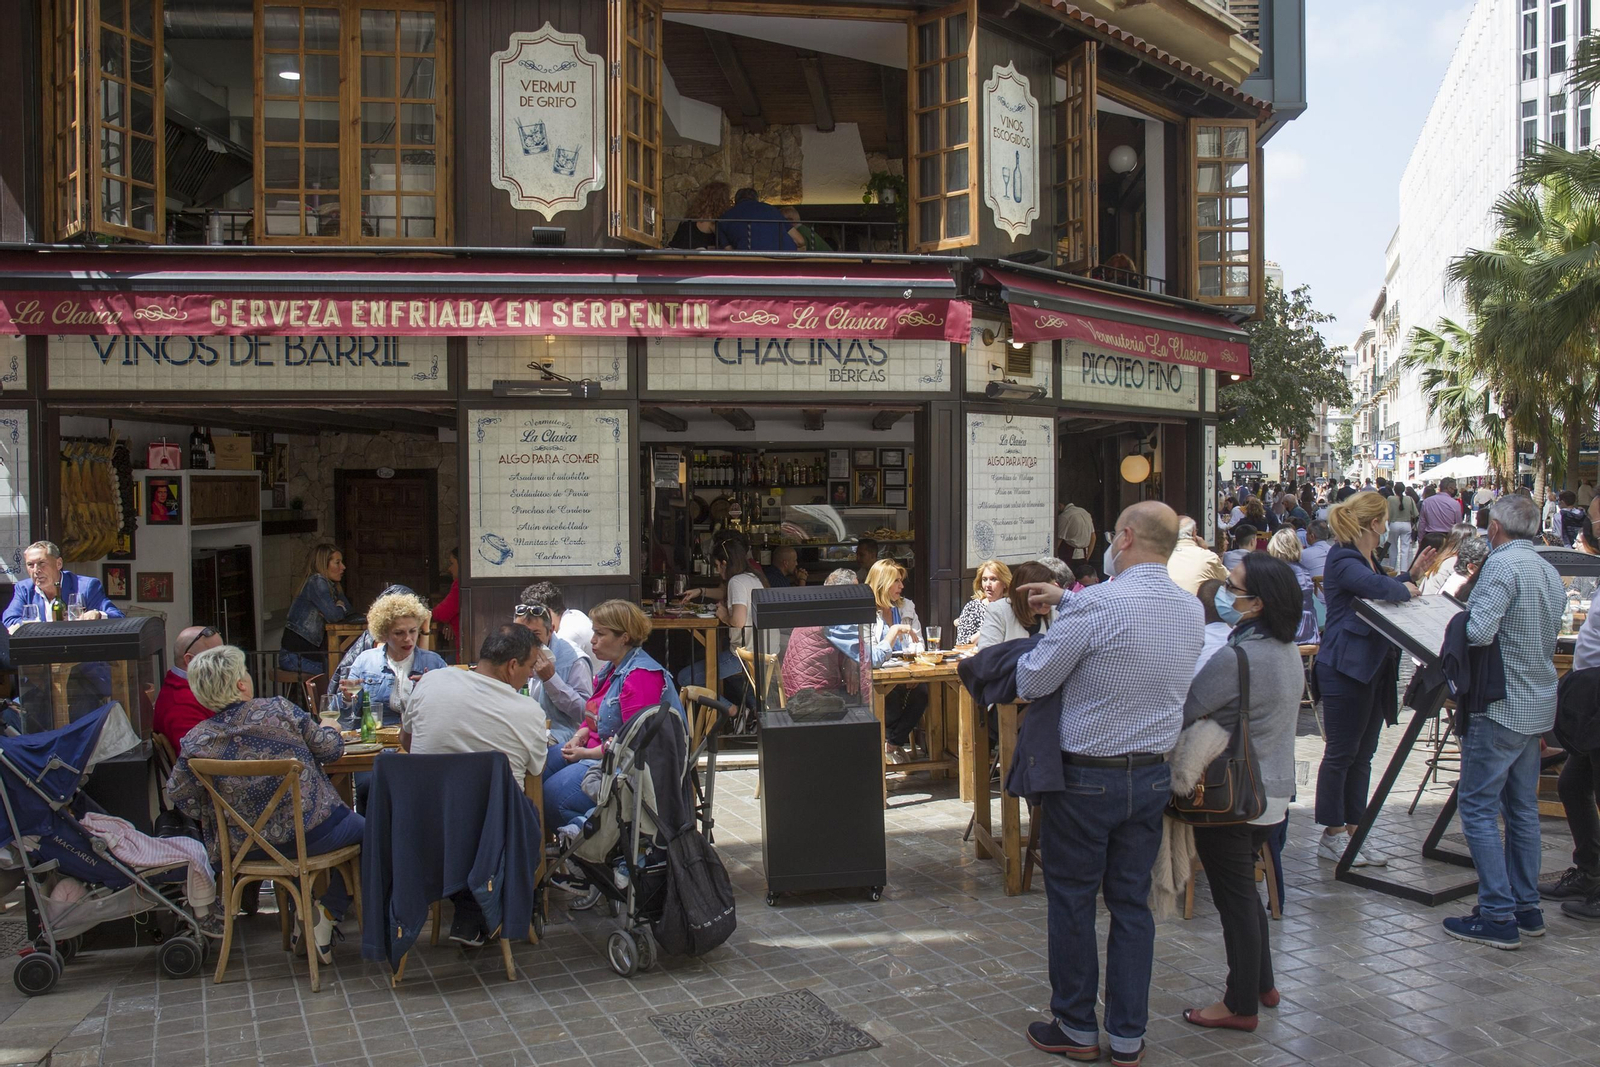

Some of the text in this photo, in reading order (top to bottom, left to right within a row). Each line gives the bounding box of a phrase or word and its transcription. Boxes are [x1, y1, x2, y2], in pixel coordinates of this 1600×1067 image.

[520, 79, 577, 94] VERMUT
[519, 95, 577, 109] DE GRIFO
[1000, 114, 1024, 133] VINOS
[993, 126, 1031, 149] ESCOGIDOS
[9, 299, 123, 326] La Clasica
[210, 299, 710, 330] CERVEZA ENFRIADA EN SERPENTIN
[787, 305, 888, 331] La Clasica
[1076, 318, 1209, 364] Vermuteria La Clasica
[89, 335, 411, 367] VINOS DE BARRIL
[713, 337, 889, 366] CHACINAS
[828, 366, 886, 383] IBÉRICAS
[1081, 351, 1183, 394] PICOTEO FINO
[519, 428, 578, 443] La Clasica
[498, 453, 600, 464] ALGO PARA COMER
[1377, 444, 1394, 460] P
[987, 455, 1038, 469] ALGO PARA PICAR
[1233, 461, 1259, 470] UDON
[552, 488, 562, 497] de
[511, 505, 592, 515] Pinchos de Cordero
[542, 521, 589, 531] encebollado
[512, 537, 548, 546] Manitas
[549, 537, 559, 546] de
[52, 835, 98, 867] MACLAREN
